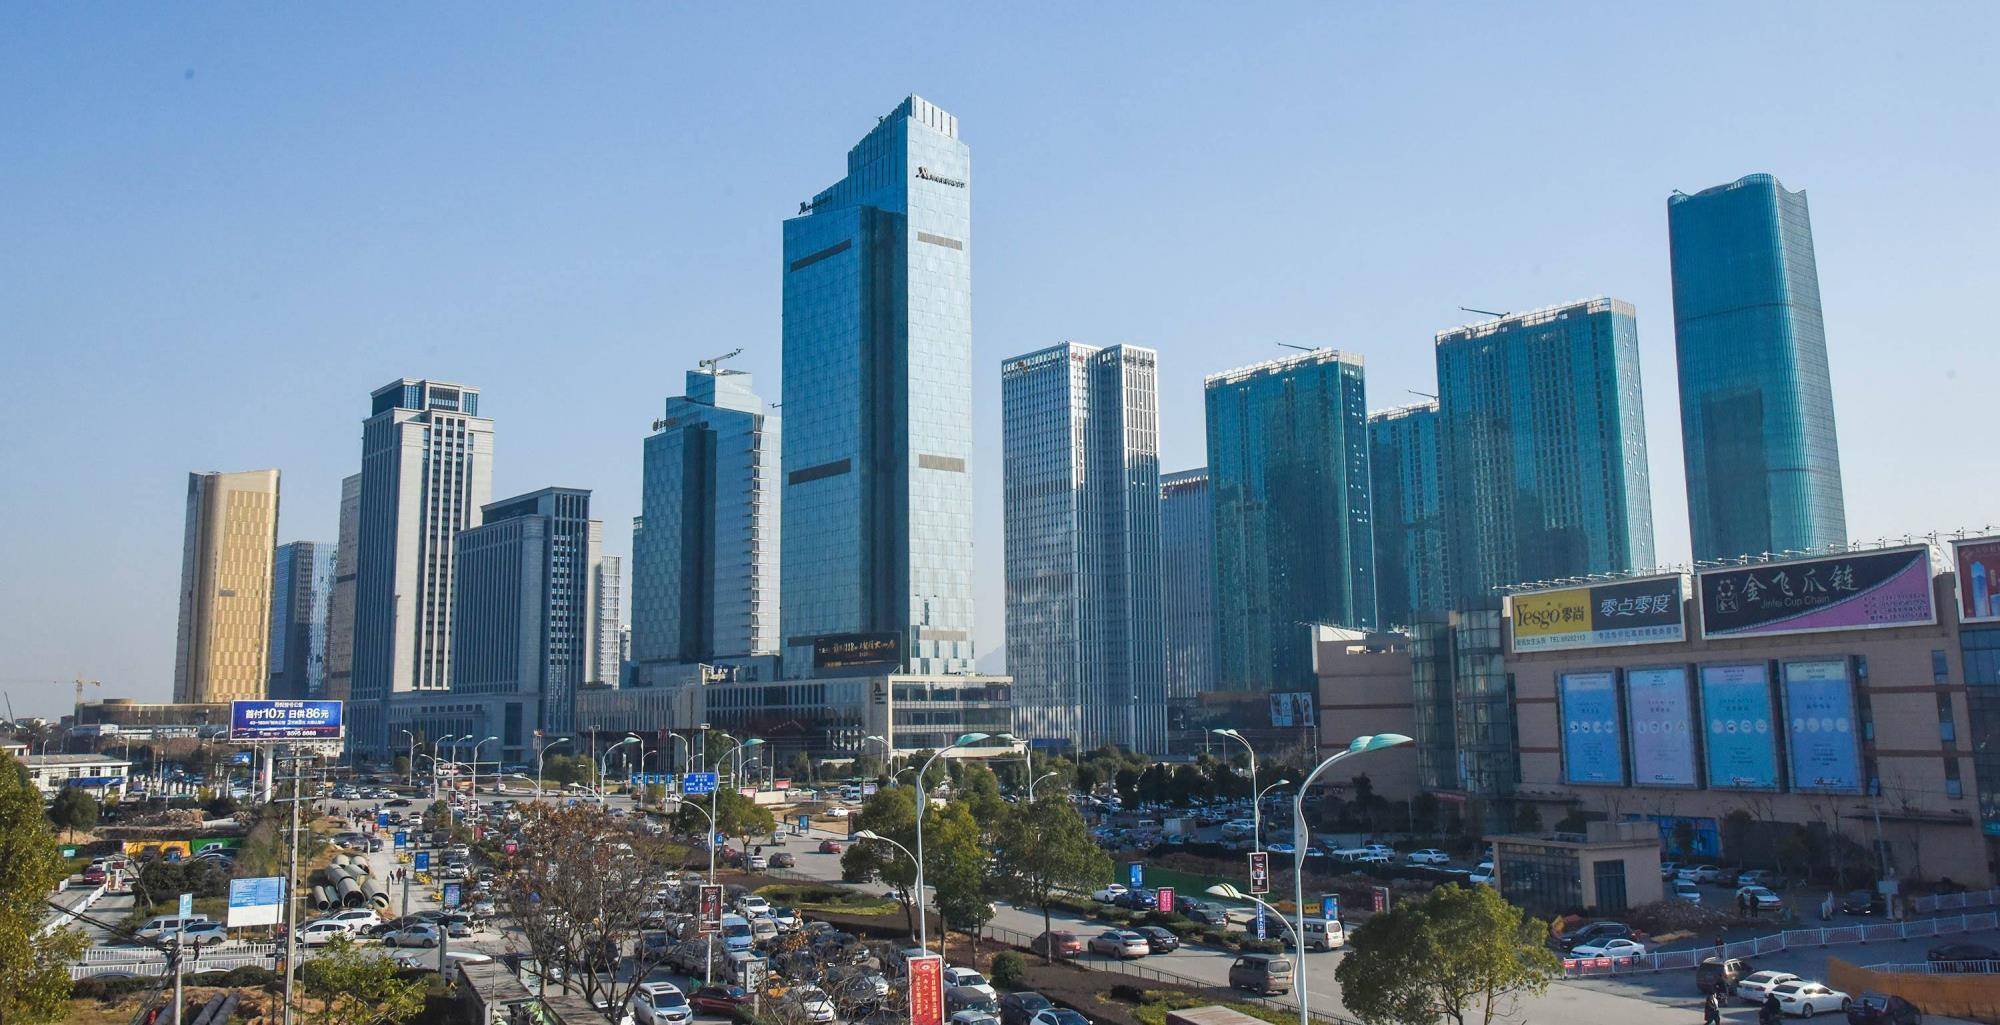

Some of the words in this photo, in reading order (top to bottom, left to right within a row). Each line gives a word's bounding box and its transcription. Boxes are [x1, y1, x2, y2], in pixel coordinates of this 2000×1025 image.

[1741, 563, 1860, 602] 金飞爪链
[1601, 594, 1670, 617] 零点零度
[1783, 597, 1803, 608] Cup
[1516, 603, 1560, 630] Yesgo
[245, 708, 286, 719] 首付10万
[288, 708, 330, 719] 日供86元
